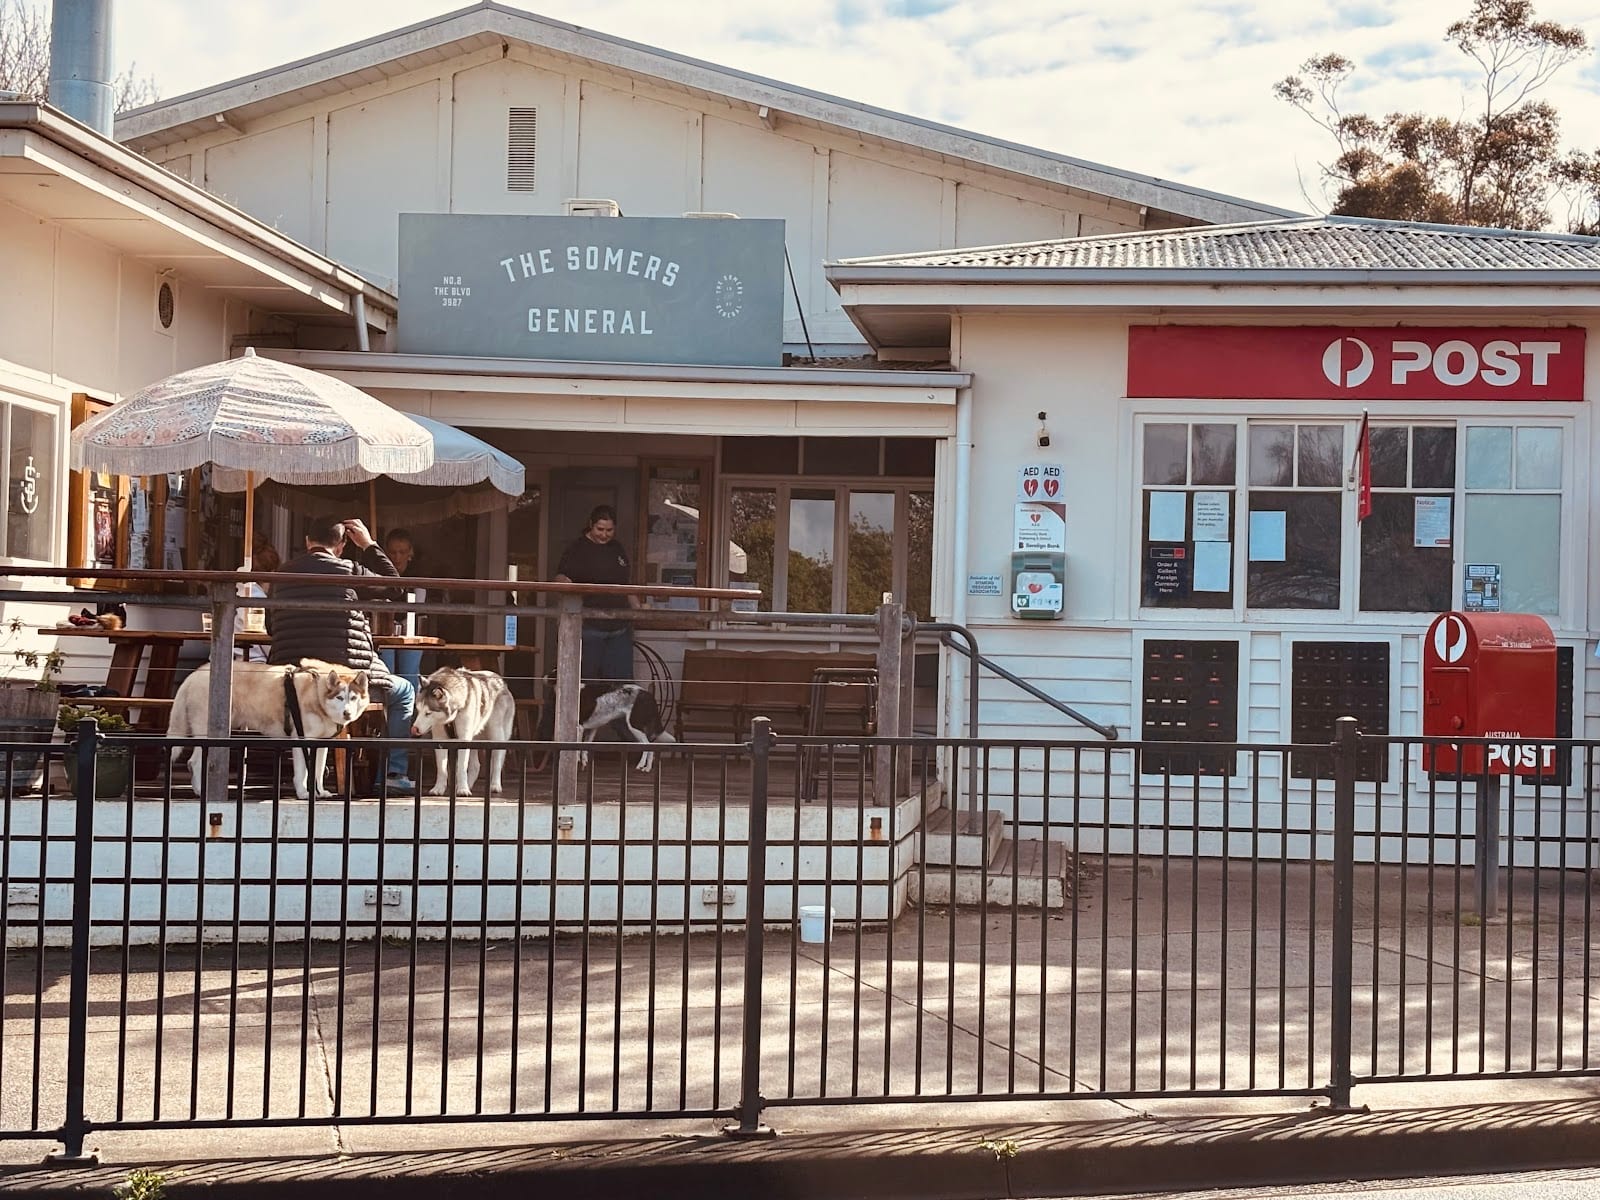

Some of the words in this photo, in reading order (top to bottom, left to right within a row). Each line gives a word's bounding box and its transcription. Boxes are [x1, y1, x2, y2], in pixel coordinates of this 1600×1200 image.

[500, 249, 554, 282] THE
[566, 246, 680, 287] SOMERS
[433, 287, 448, 296] THE
[528, 308, 653, 334] GENERAL
[1391, 340, 1560, 387] POST
[1023, 467, 1039, 476] AED
[1043, 467, 1060, 477] AED
[1484, 731, 1521, 739] AUSTRALIA
[1488, 744, 1557, 768] POST
